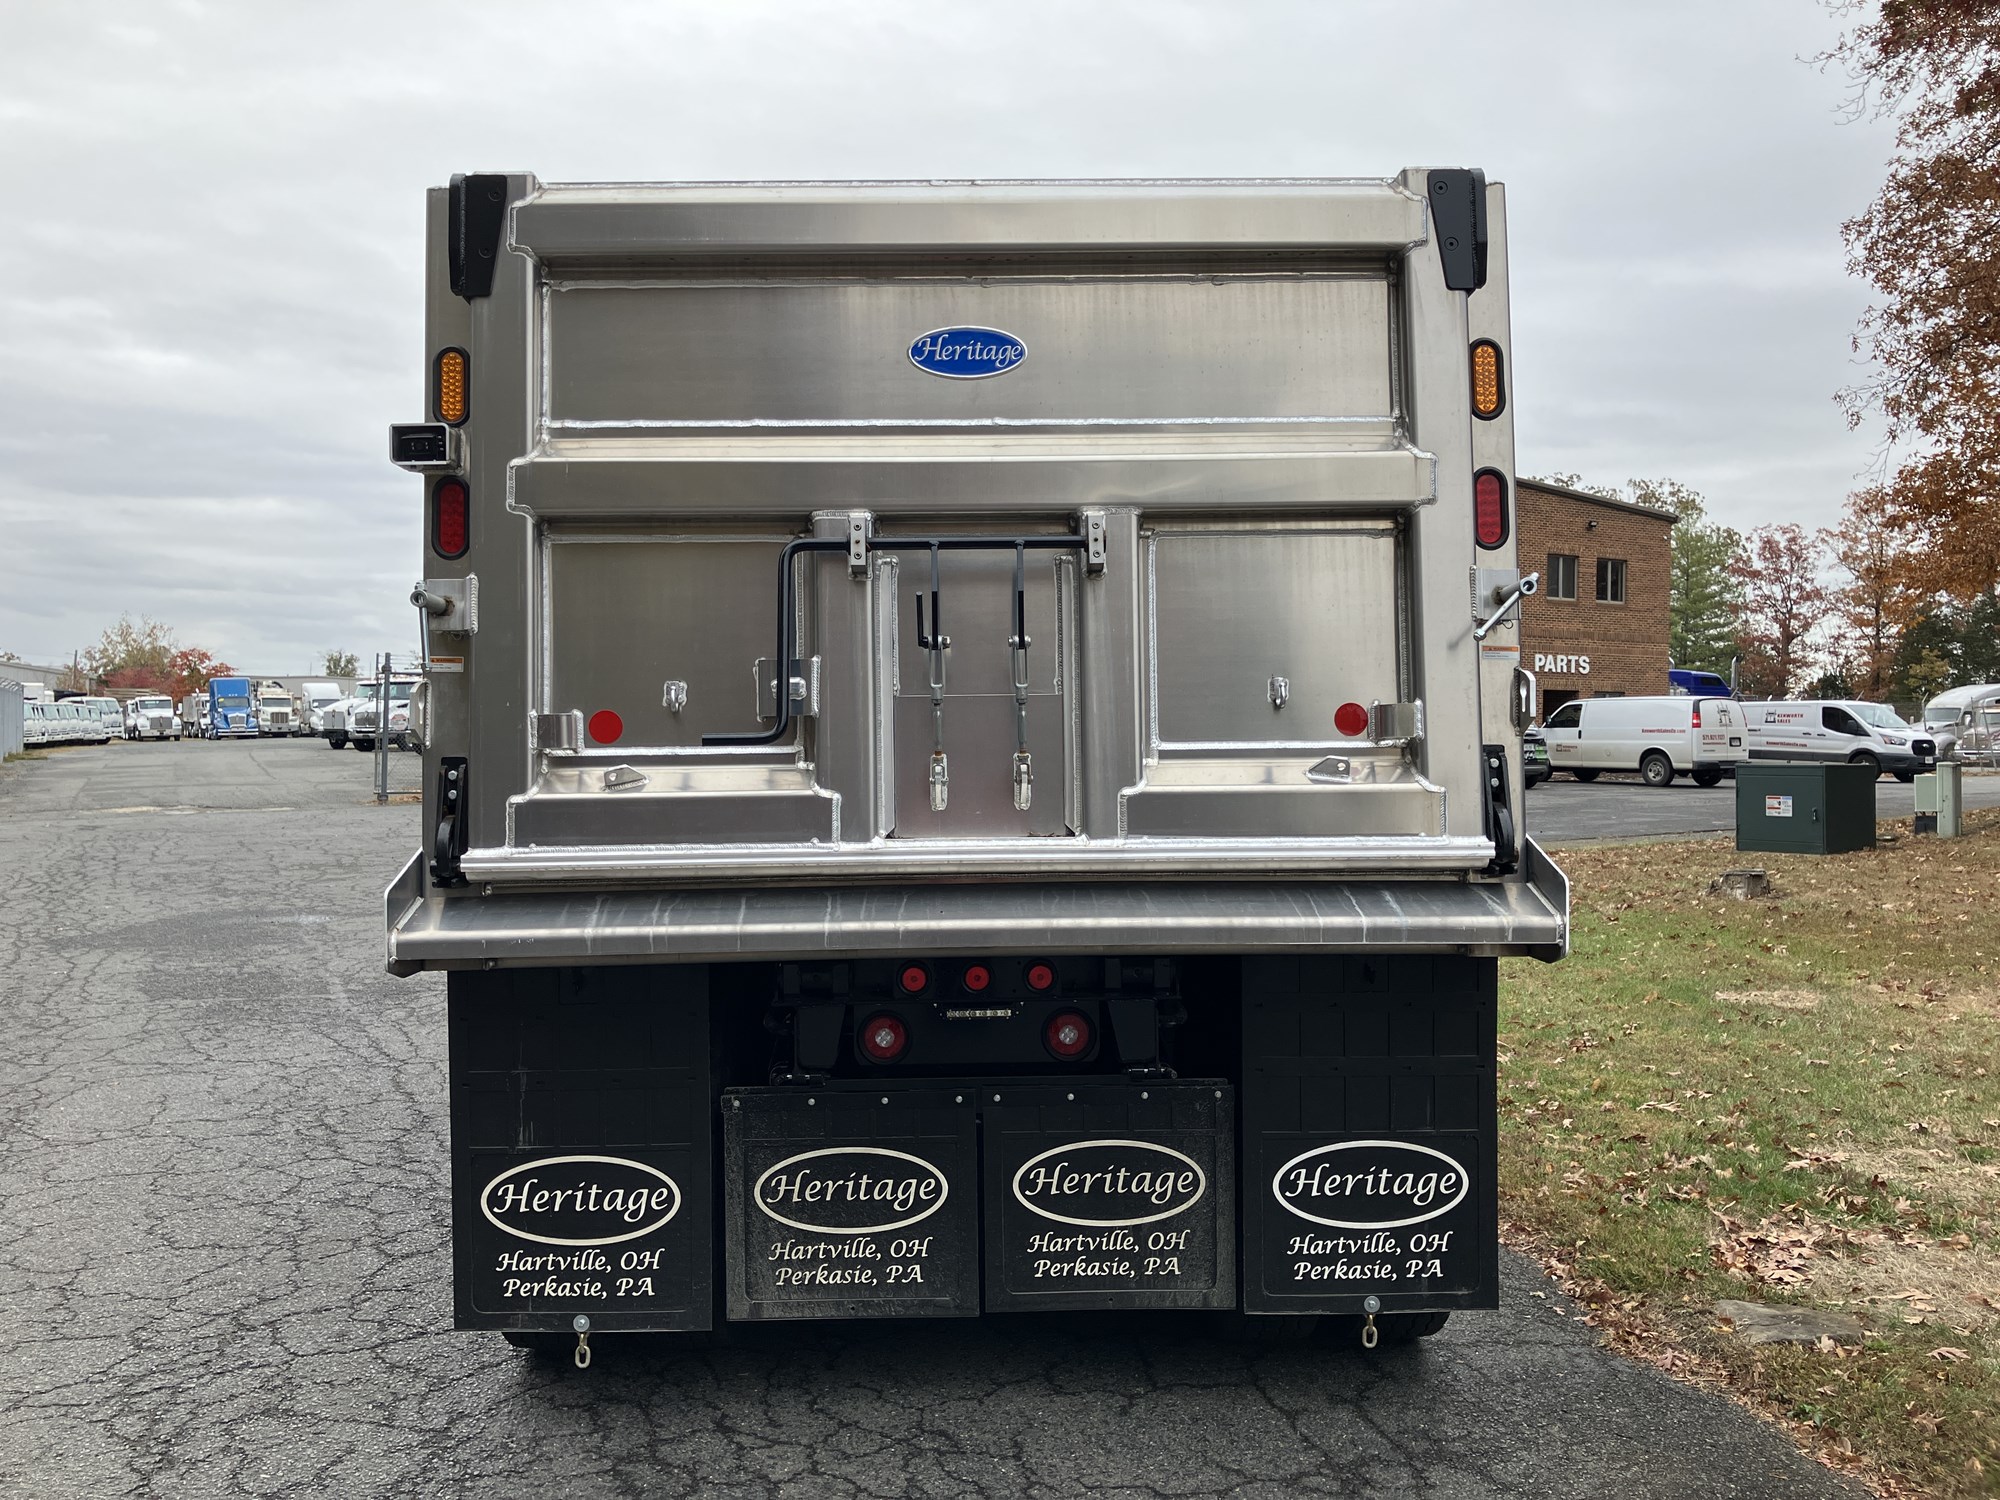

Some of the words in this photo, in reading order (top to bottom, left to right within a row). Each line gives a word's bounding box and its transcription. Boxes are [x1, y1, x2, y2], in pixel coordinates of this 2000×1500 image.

[913, 333, 1022, 368] Heritage
[1534, 653, 1590, 675] PARTS
[765, 1169, 936, 1212] Heritage
[1024, 1162, 1194, 1205] Heritage
[1284, 1163, 1457, 1206] Heritage
[492, 1178, 669, 1223] Heritage
[767, 1237, 882, 1261] Hartville,
[890, 1236, 934, 1258] OH
[1026, 1229, 1140, 1253] Hartville,
[1147, 1229, 1191, 1251] OH
[1286, 1231, 1402, 1256] Hartville,
[1409, 1230, 1454, 1253] OH
[495, 1249, 612, 1274] Hartville,
[620, 1247, 666, 1271] OH
[1033, 1255, 1135, 1278] Perkasie,
[1143, 1256, 1182, 1276] PA
[1293, 1258, 1398, 1282] Perkasie,
[1405, 1258, 1444, 1278] PA
[502, 1275, 608, 1300] Perkasie,
[615, 1276, 656, 1297] PA
[775, 1263, 878, 1287] Perkasie,
[885, 1264, 924, 1284] PA
